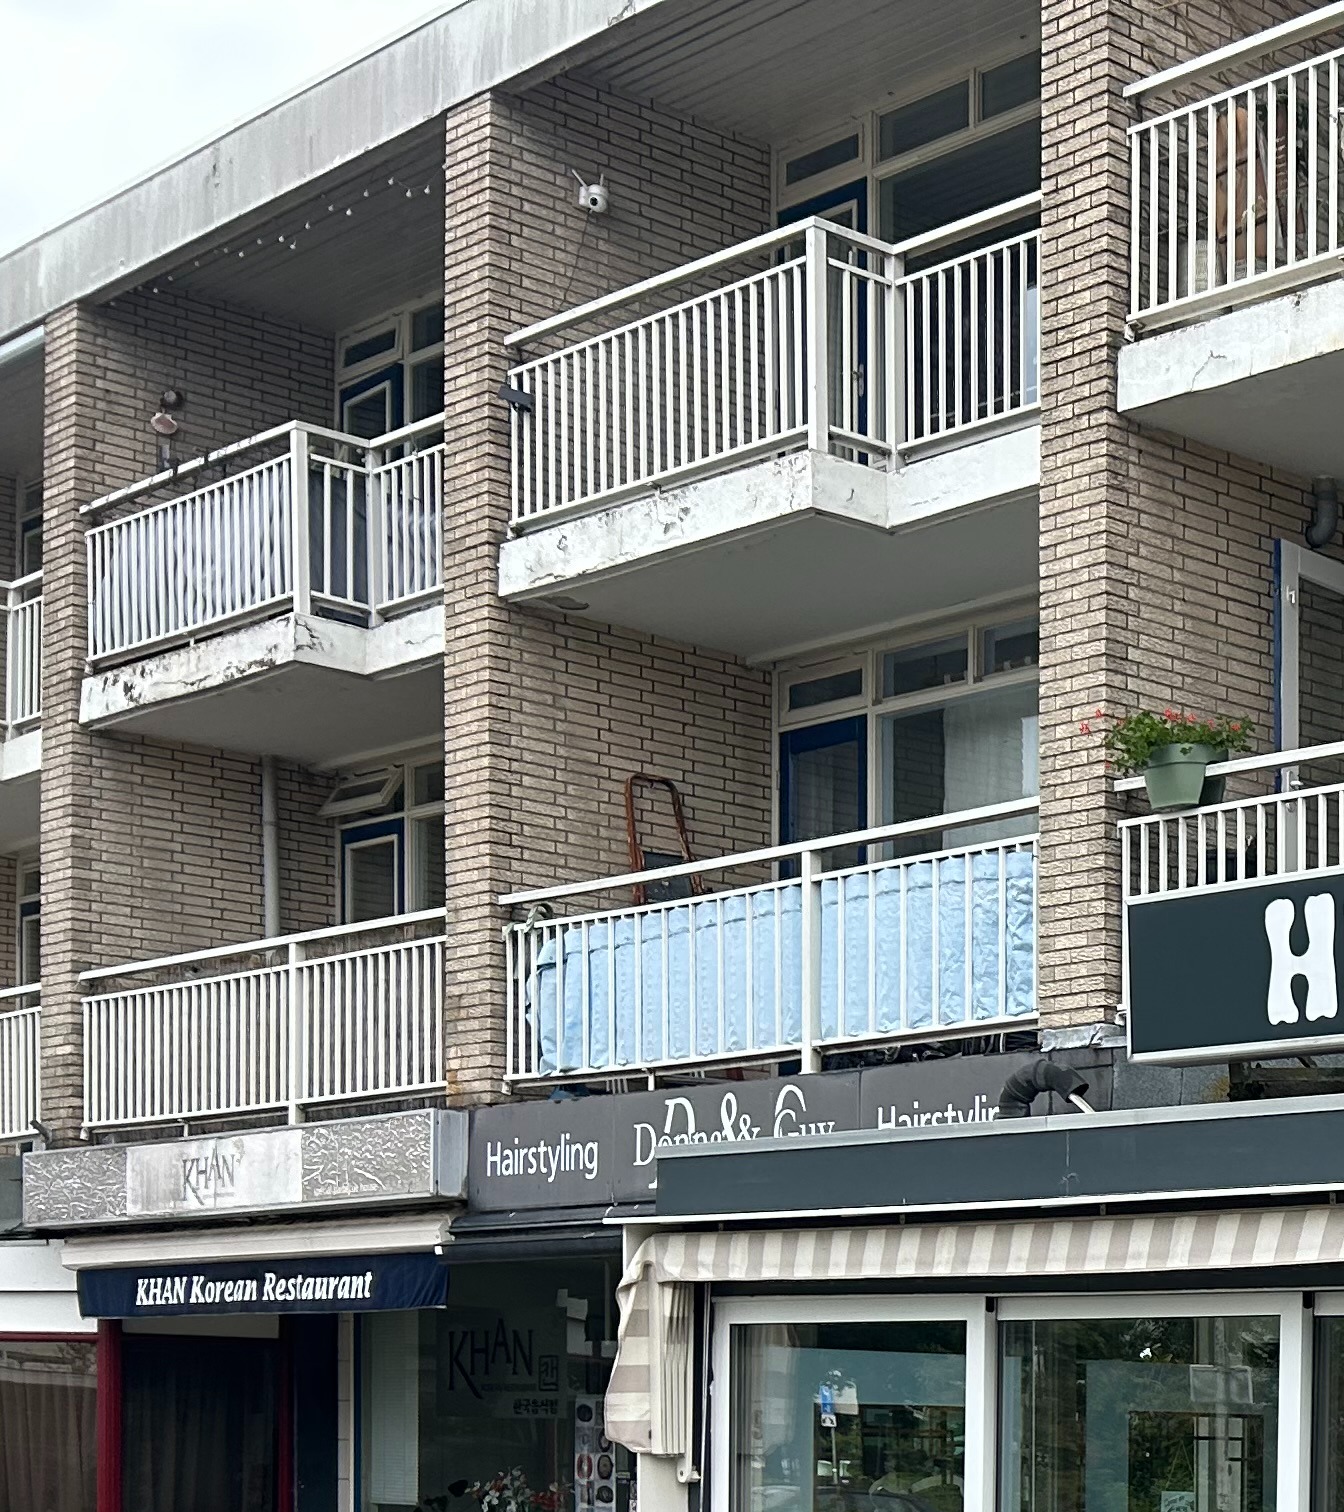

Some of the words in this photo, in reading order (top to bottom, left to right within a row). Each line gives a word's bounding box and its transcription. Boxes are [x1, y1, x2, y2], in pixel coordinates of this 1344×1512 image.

[181, 1146, 235, 1206] KHAN
[486, 1132, 599, 1183] Hairstyling
[135, 1276, 188, 1306] KHAN
[189, 1274, 258, 1304] Korean
[262, 1270, 373, 1301] Restaurant
[448, 1317, 534, 1400] KHAN
